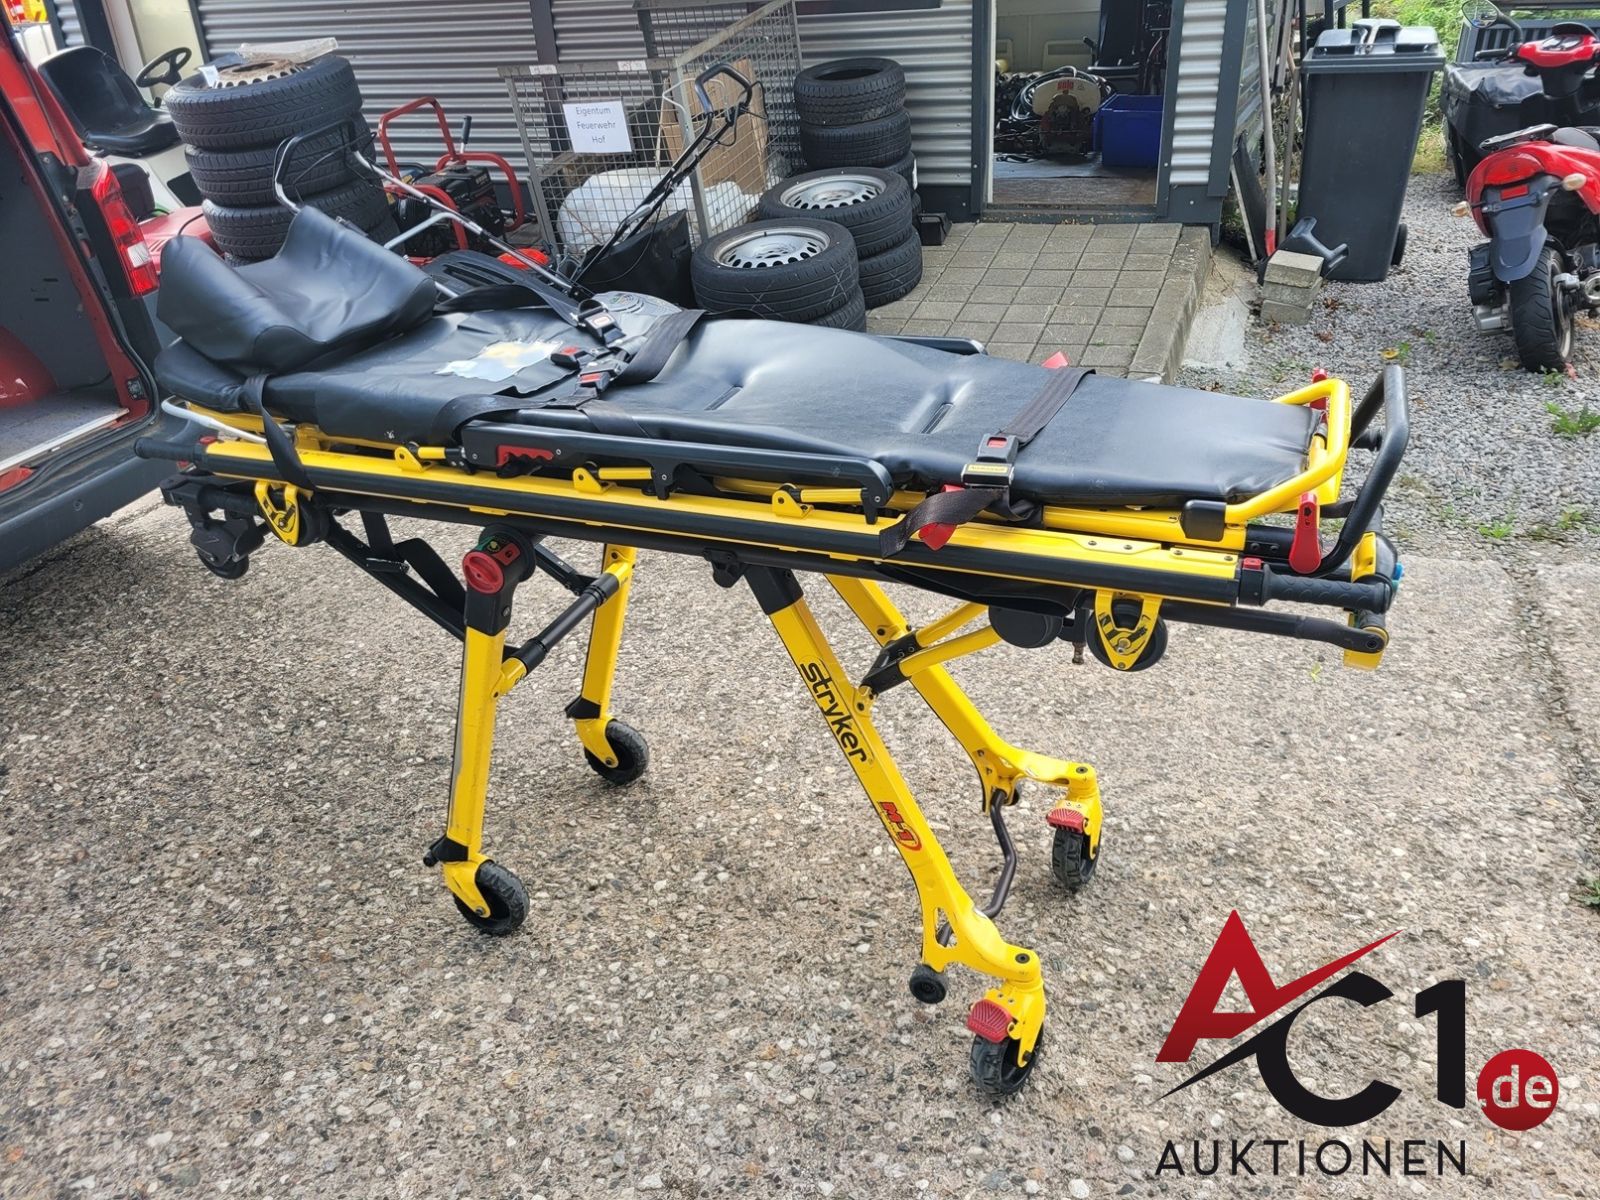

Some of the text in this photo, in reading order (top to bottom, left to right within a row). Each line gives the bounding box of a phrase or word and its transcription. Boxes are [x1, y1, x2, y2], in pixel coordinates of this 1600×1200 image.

[575, 106, 612, 117] Eigentum
[576, 121, 617, 130] Feuerwehr
[591, 135, 607, 144] Hof
[800, 662, 868, 763] stryker
